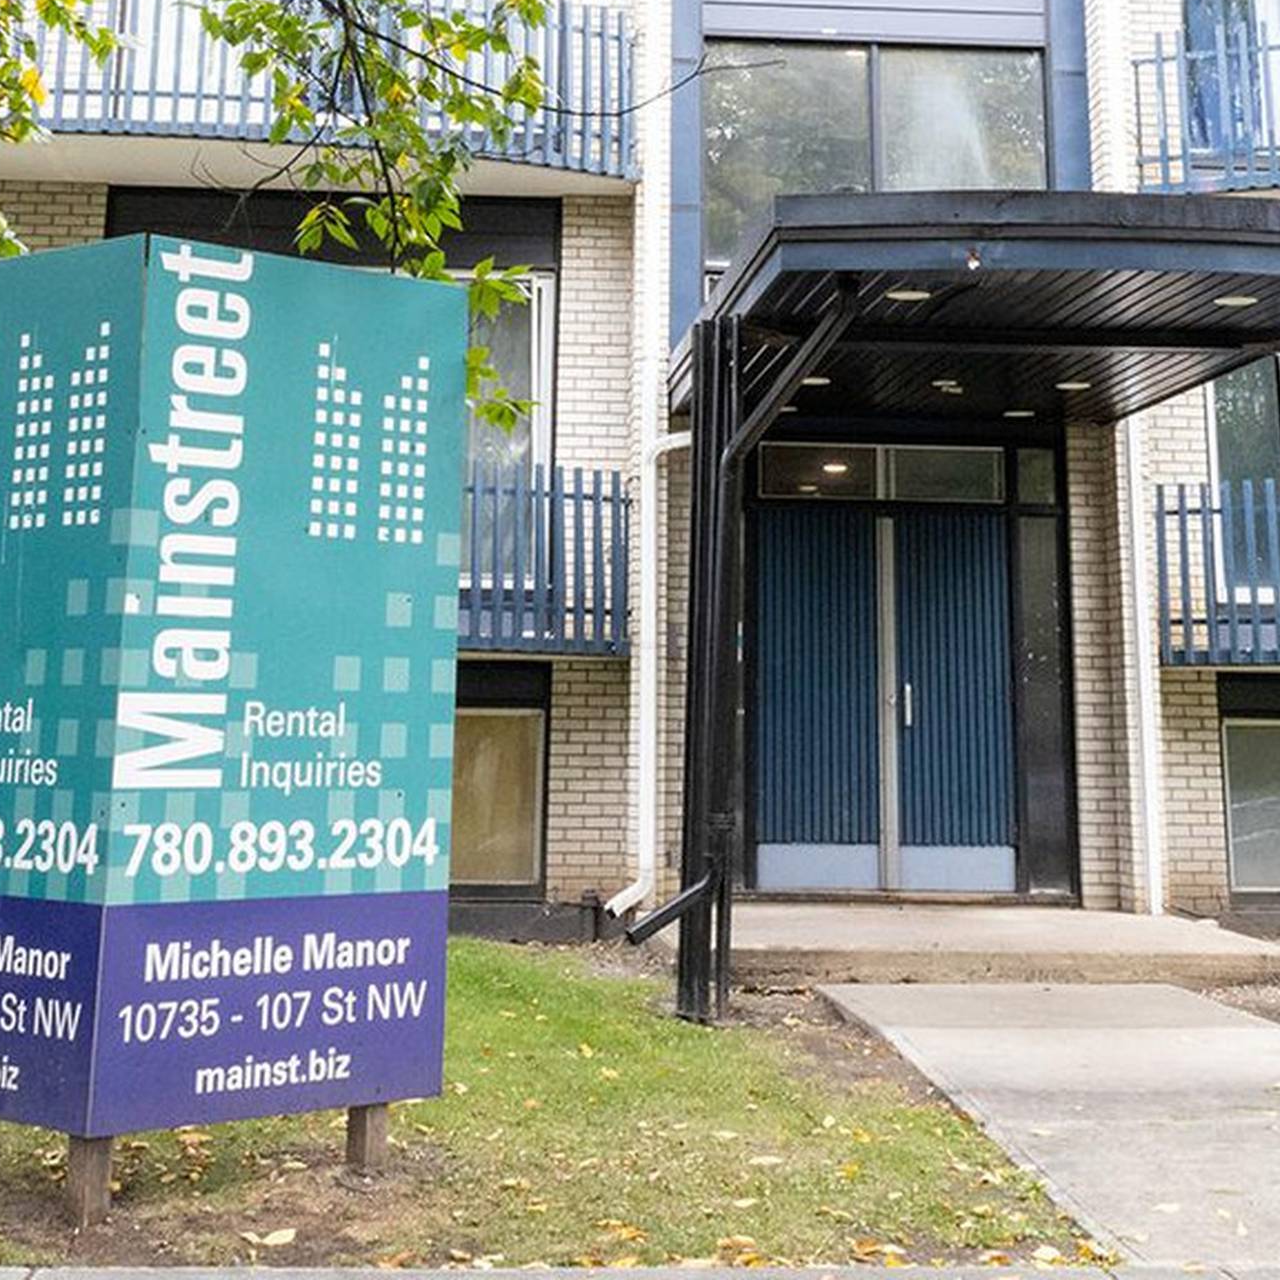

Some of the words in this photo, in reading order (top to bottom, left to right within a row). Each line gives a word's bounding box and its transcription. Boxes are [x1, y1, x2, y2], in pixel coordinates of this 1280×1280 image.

[112, 244, 255, 791] Mainstreet
[243, 701, 346, 738] Rental
[240, 750, 383, 796] Inquiries
[123, 817, 440, 877] 780.893.2304
[144, 936, 293, 983] Michelle
[303, 932, 411, 970] Manor
[0, 994, 28, 1034] St
[33, 998, 82, 1041] NW
[118, 998, 220, 1043] 10735
[256, 992, 311, 1030] 107
[321, 987, 359, 1025] St
[366, 981, 428, 1018] NW
[195, 1048, 352, 1094] mainst.biz
